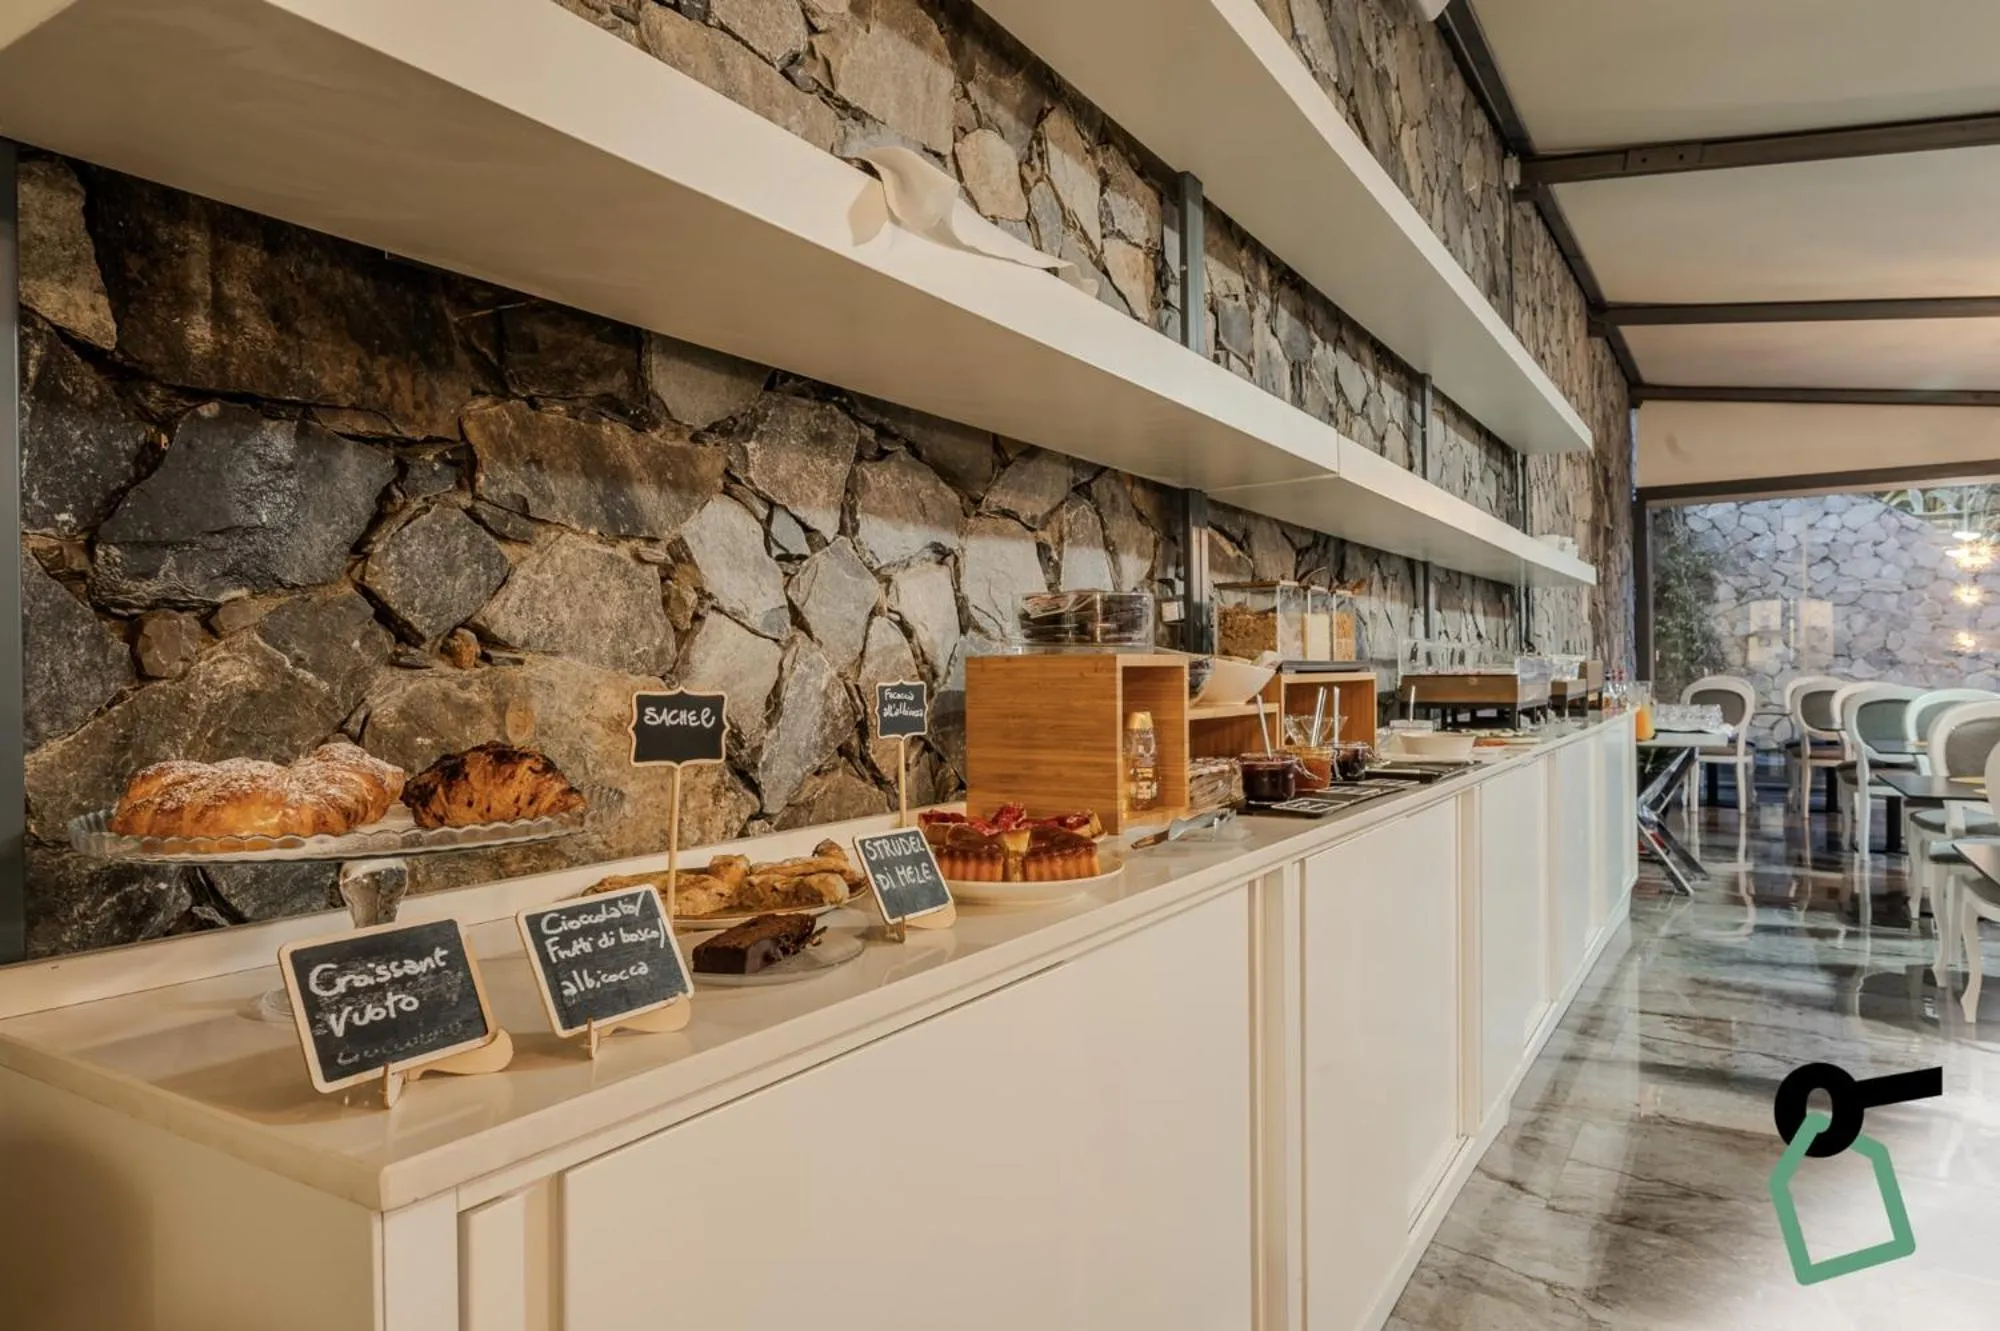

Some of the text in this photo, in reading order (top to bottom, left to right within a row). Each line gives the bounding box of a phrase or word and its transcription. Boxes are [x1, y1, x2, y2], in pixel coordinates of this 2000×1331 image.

[864, 835, 926, 861] STRUDEL
[544, 936, 594, 964] Frutti
[597, 931, 616, 949] di
[308, 946, 449, 997] Croissant
